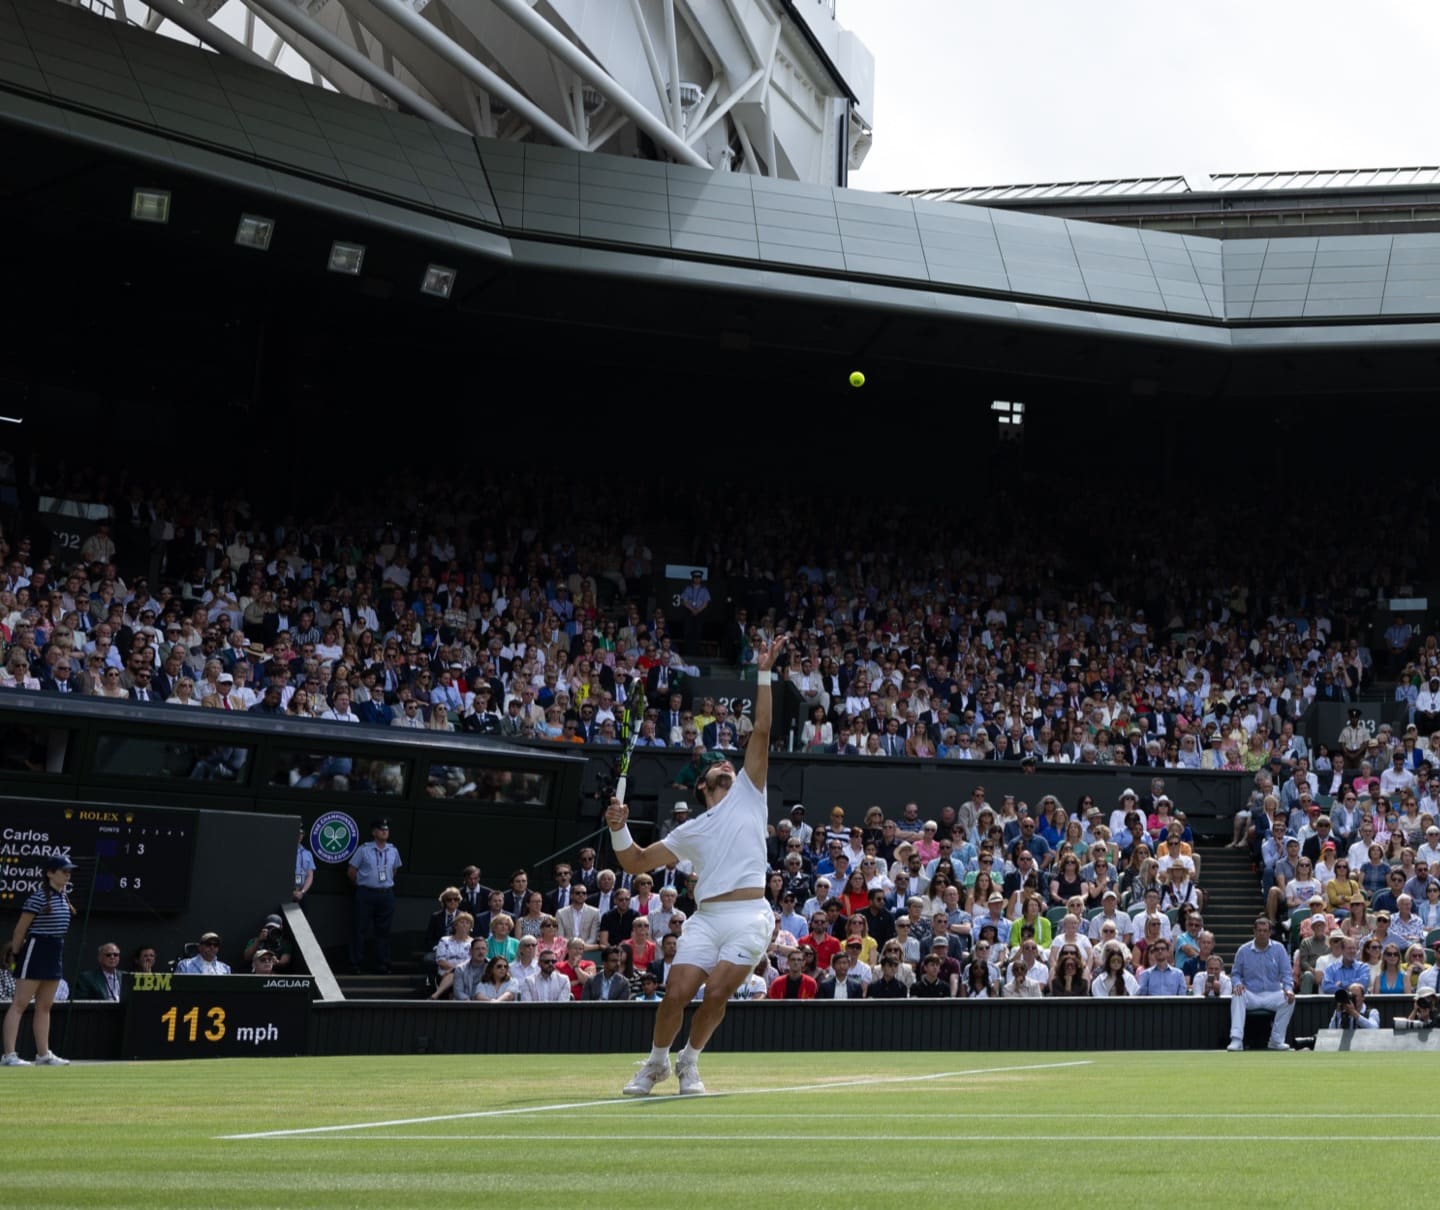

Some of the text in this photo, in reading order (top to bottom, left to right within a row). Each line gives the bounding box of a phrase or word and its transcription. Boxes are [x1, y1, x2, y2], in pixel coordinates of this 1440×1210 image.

[80, 811, 119, 821] ROLEX
[3, 828, 49, 842] Carlos
[0, 844, 71, 857] ALCARAZ
[137, 843, 145, 855] 3
[120, 877, 128, 889] 6
[132, 877, 141, 889] 3
[133, 974, 310, 991] IBM JAGUAR
[161, 1006, 279, 1045] 113 mph
